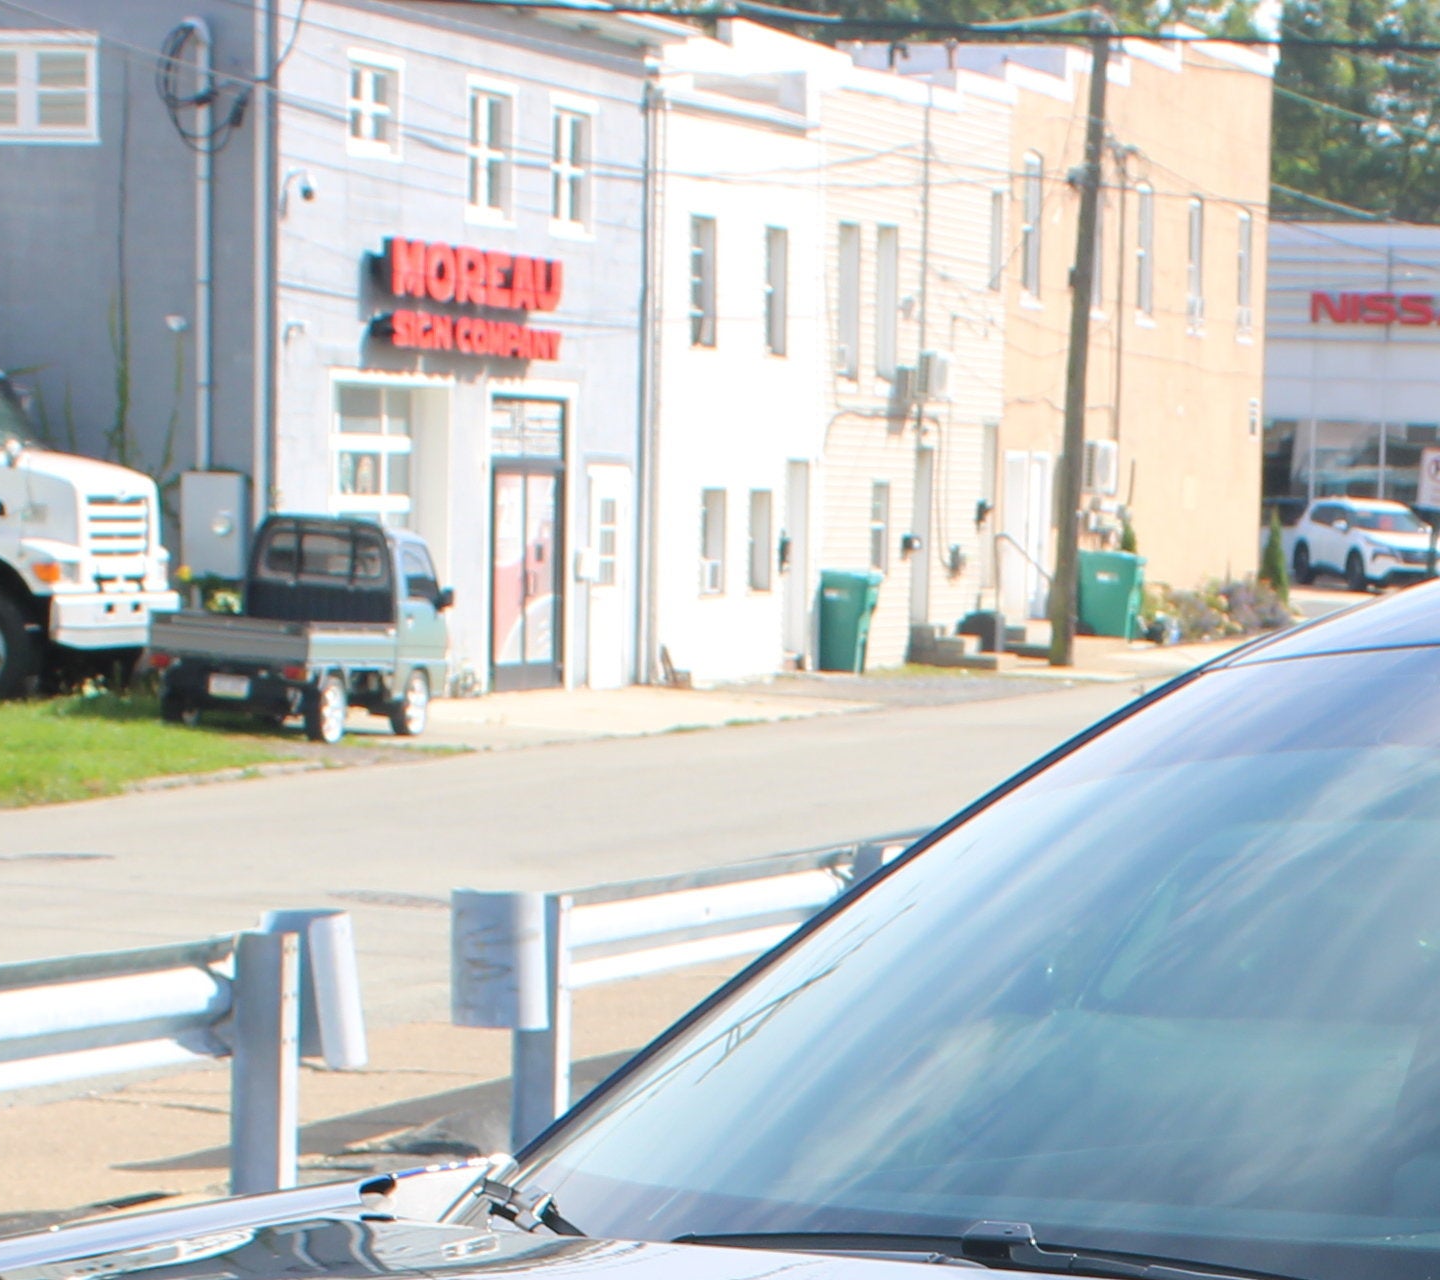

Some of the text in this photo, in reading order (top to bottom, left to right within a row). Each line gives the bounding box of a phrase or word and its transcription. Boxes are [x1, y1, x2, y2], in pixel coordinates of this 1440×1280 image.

[392, 237, 563, 312] MOREAU
[392, 312, 561, 360] SIGN COMPANY
